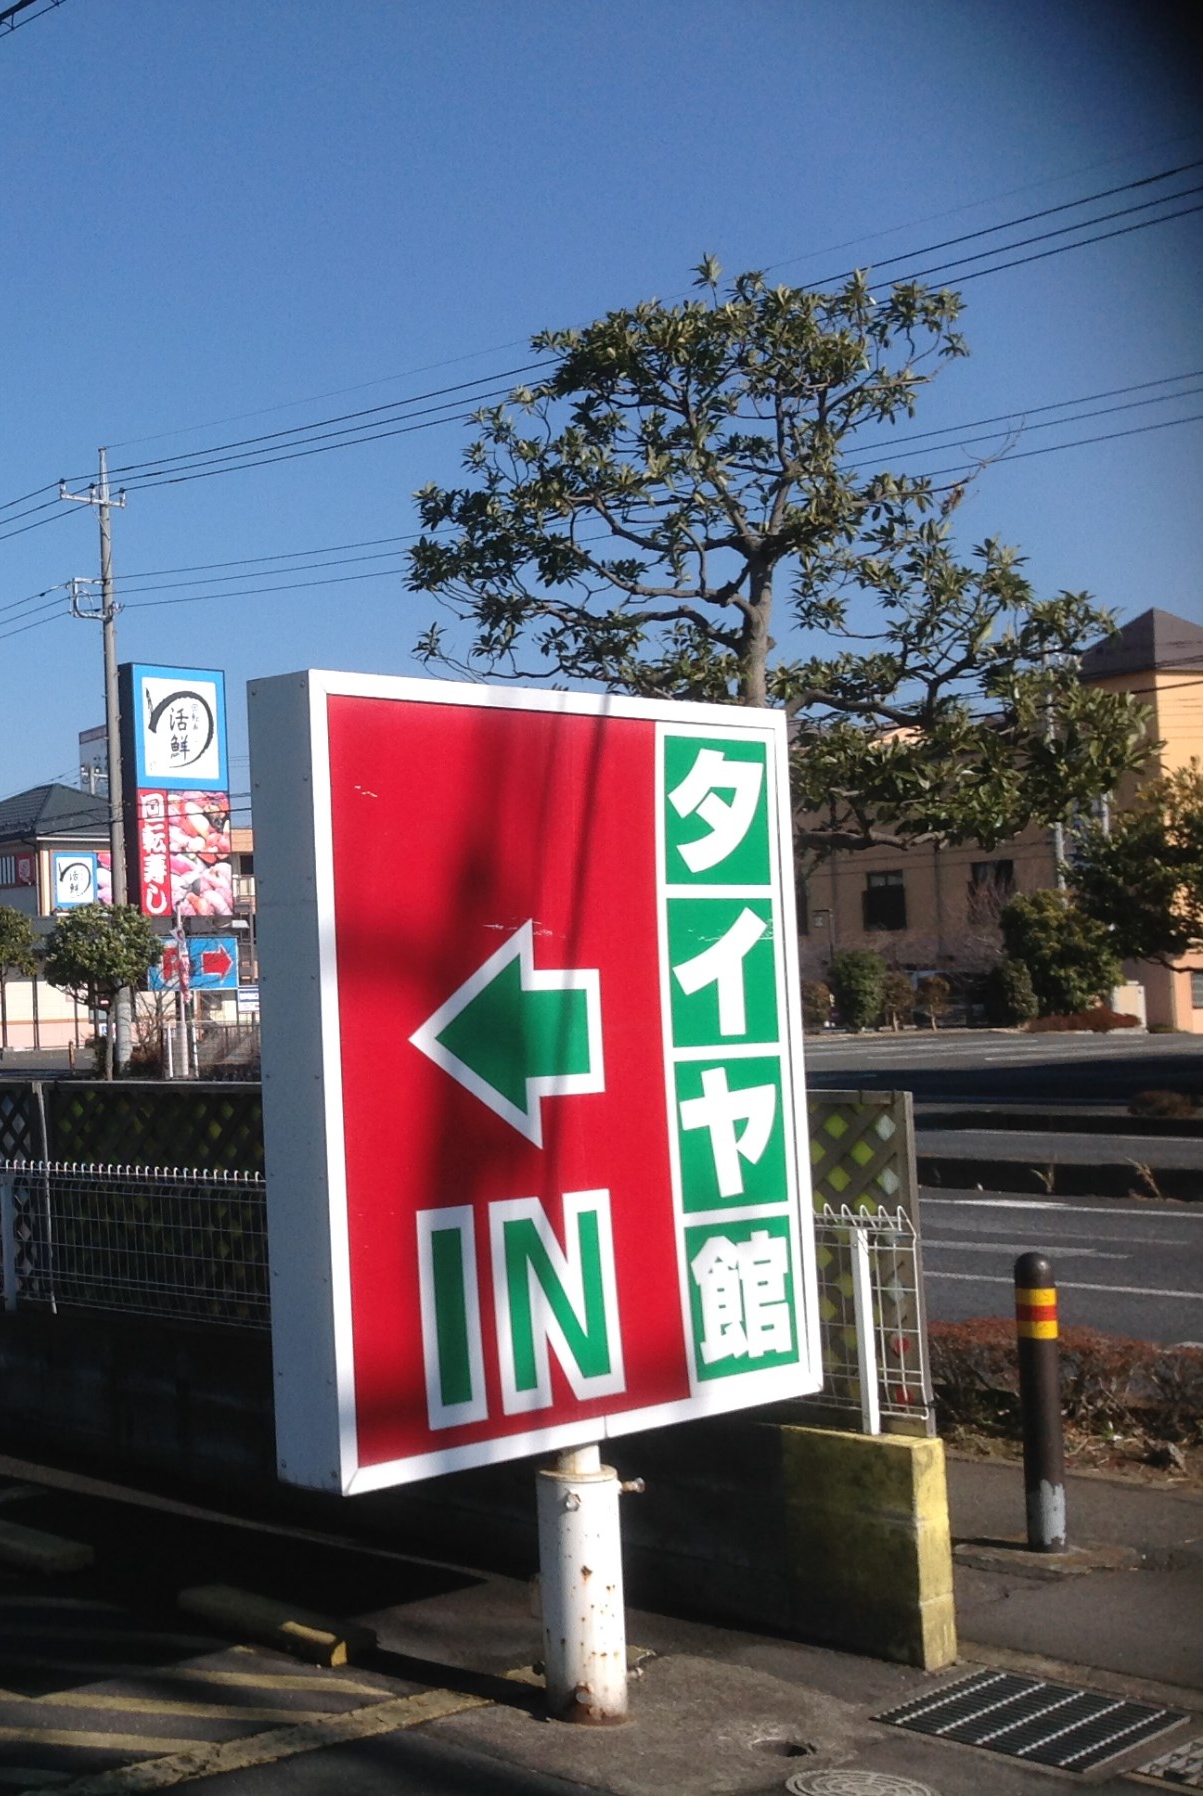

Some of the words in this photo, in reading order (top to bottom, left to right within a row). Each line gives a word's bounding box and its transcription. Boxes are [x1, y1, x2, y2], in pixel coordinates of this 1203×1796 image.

[169, 706, 191, 761] 活鮮
[140, 793, 168, 914] 回転寿し
[669, 746, 794, 1364] タイヤ館
[416, 1189, 626, 1431] IN
